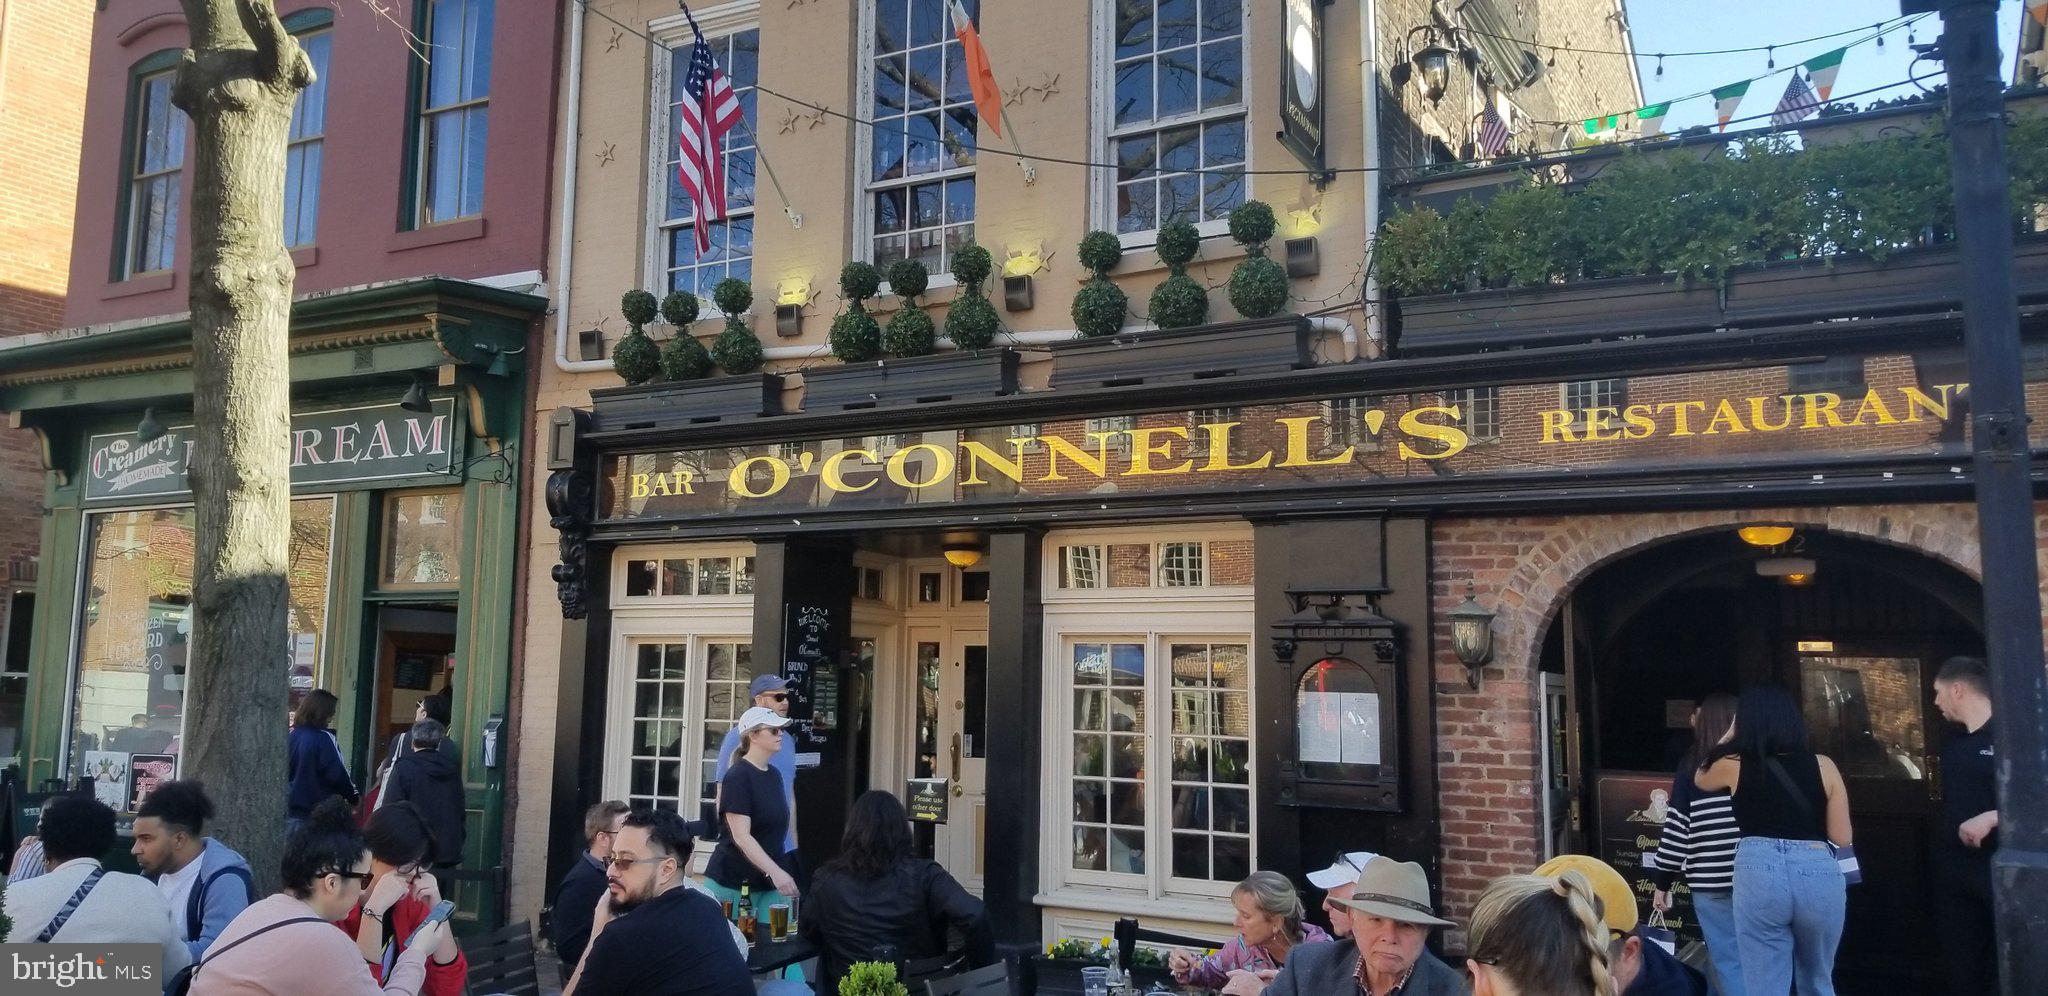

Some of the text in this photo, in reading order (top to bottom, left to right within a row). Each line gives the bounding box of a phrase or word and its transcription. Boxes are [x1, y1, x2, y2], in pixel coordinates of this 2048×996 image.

[112, 441, 128, 451] The
[289, 415, 447, 468] REAM
[93, 434, 177, 479] Creamery
[630, 471, 696, 499] BAR
[728, 404, 1469, 498] O'CONNELL'S
[118, 462, 166, 488] HOMEMADE
[798, 613, 831, 631] WELCOME
[809, 625, 818, 633] TO
[913, 794, 932, 803] Please
[928, 804, 942, 812] door
[1636, 834, 1660, 850] Open
[1636, 879, 1656, 895] Hap
